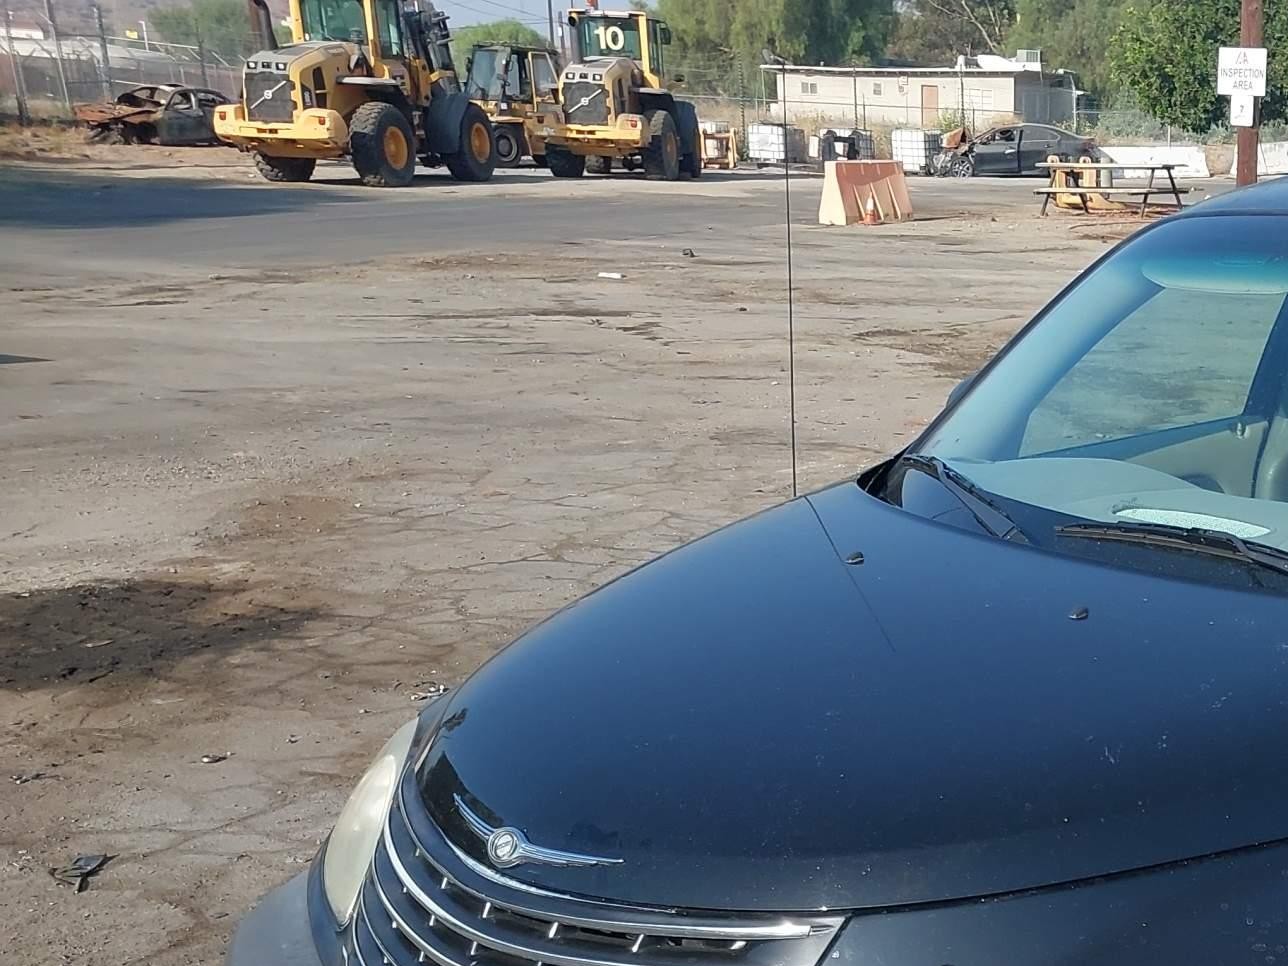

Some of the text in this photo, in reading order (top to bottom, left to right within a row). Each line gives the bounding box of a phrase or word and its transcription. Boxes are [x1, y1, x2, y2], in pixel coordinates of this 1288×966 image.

[594, 25, 625, 51] 10
[1220, 67, 1264, 78] INSPECTION
[1232, 80, 1253, 90] AREA
